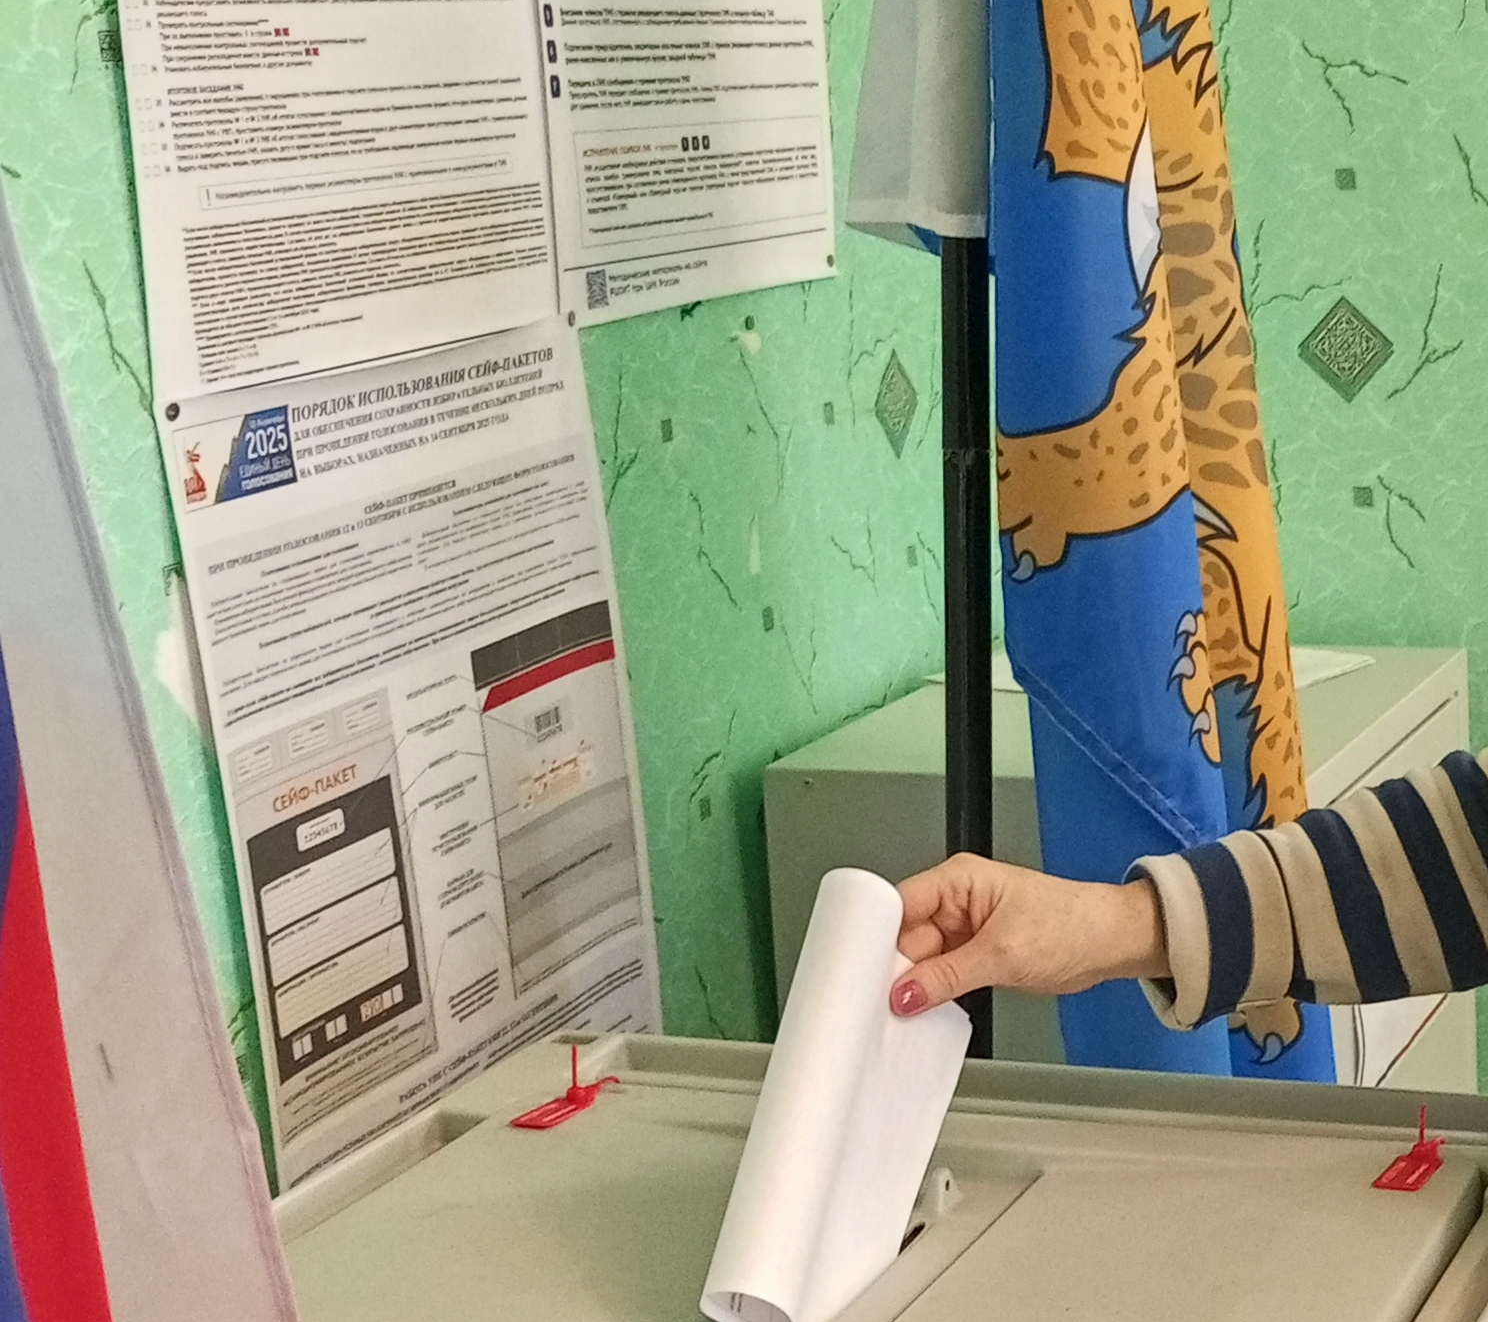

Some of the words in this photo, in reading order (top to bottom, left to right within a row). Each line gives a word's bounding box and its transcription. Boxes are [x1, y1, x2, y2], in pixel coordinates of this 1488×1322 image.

[291, 393, 355, 423] ПОРЯДОК
[358, 367, 466, 407] ИСПОЛЬЗОВАНИЯ
[467, 347, 554, 380] СЕЙФ-ПАКЕТОВ
[244, 424, 289, 460] 2025
[272, 764, 358, 813] СЕЙФ-ПАКЕТ
